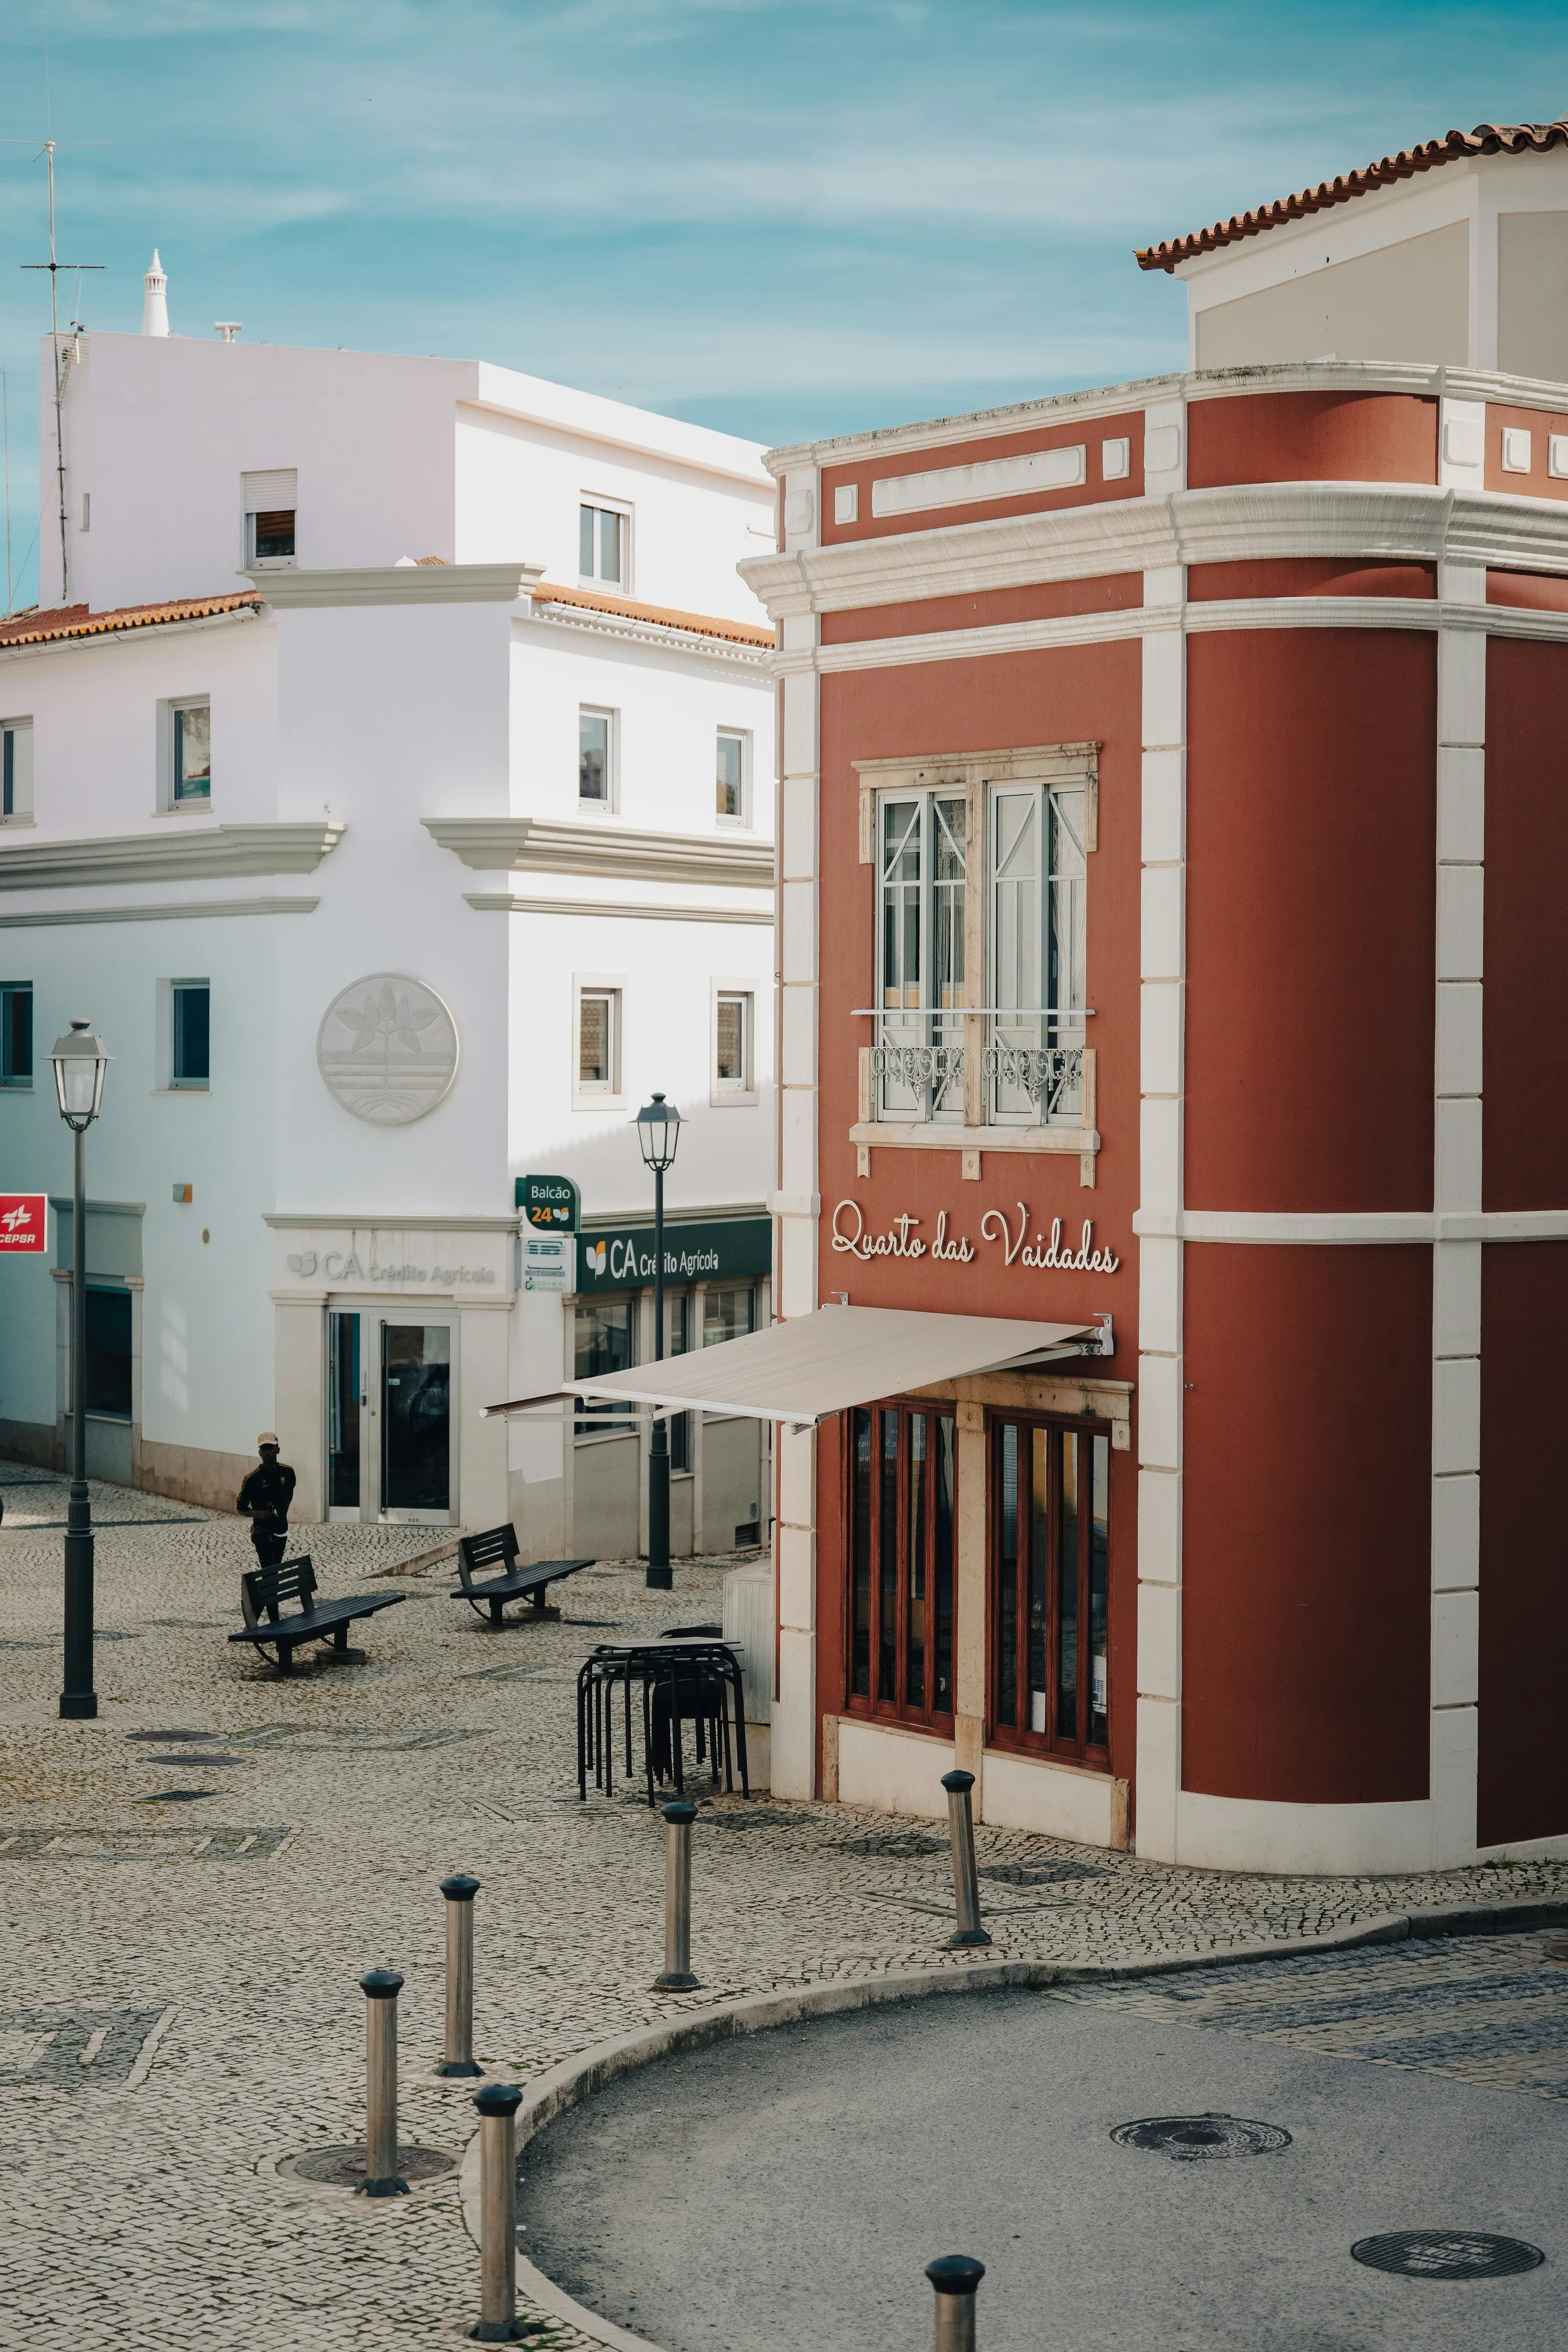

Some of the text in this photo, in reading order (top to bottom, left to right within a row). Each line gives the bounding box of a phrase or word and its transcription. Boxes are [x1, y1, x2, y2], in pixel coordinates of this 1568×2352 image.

[531, 1185, 571, 1199] Balcão
[532, 1206, 552, 1222] 24
[0, 1234, 36, 1243] CEPSA
[832, 1199, 1119, 1273] Quarto das Vaidades
[322, 1251, 364, 1281] CA
[369, 1264, 427, 1282] Crédito
[610, 1239, 719, 1279] CA Créito Agrícola
[1406, 2245, 1491, 2264] PLUVIAIS
